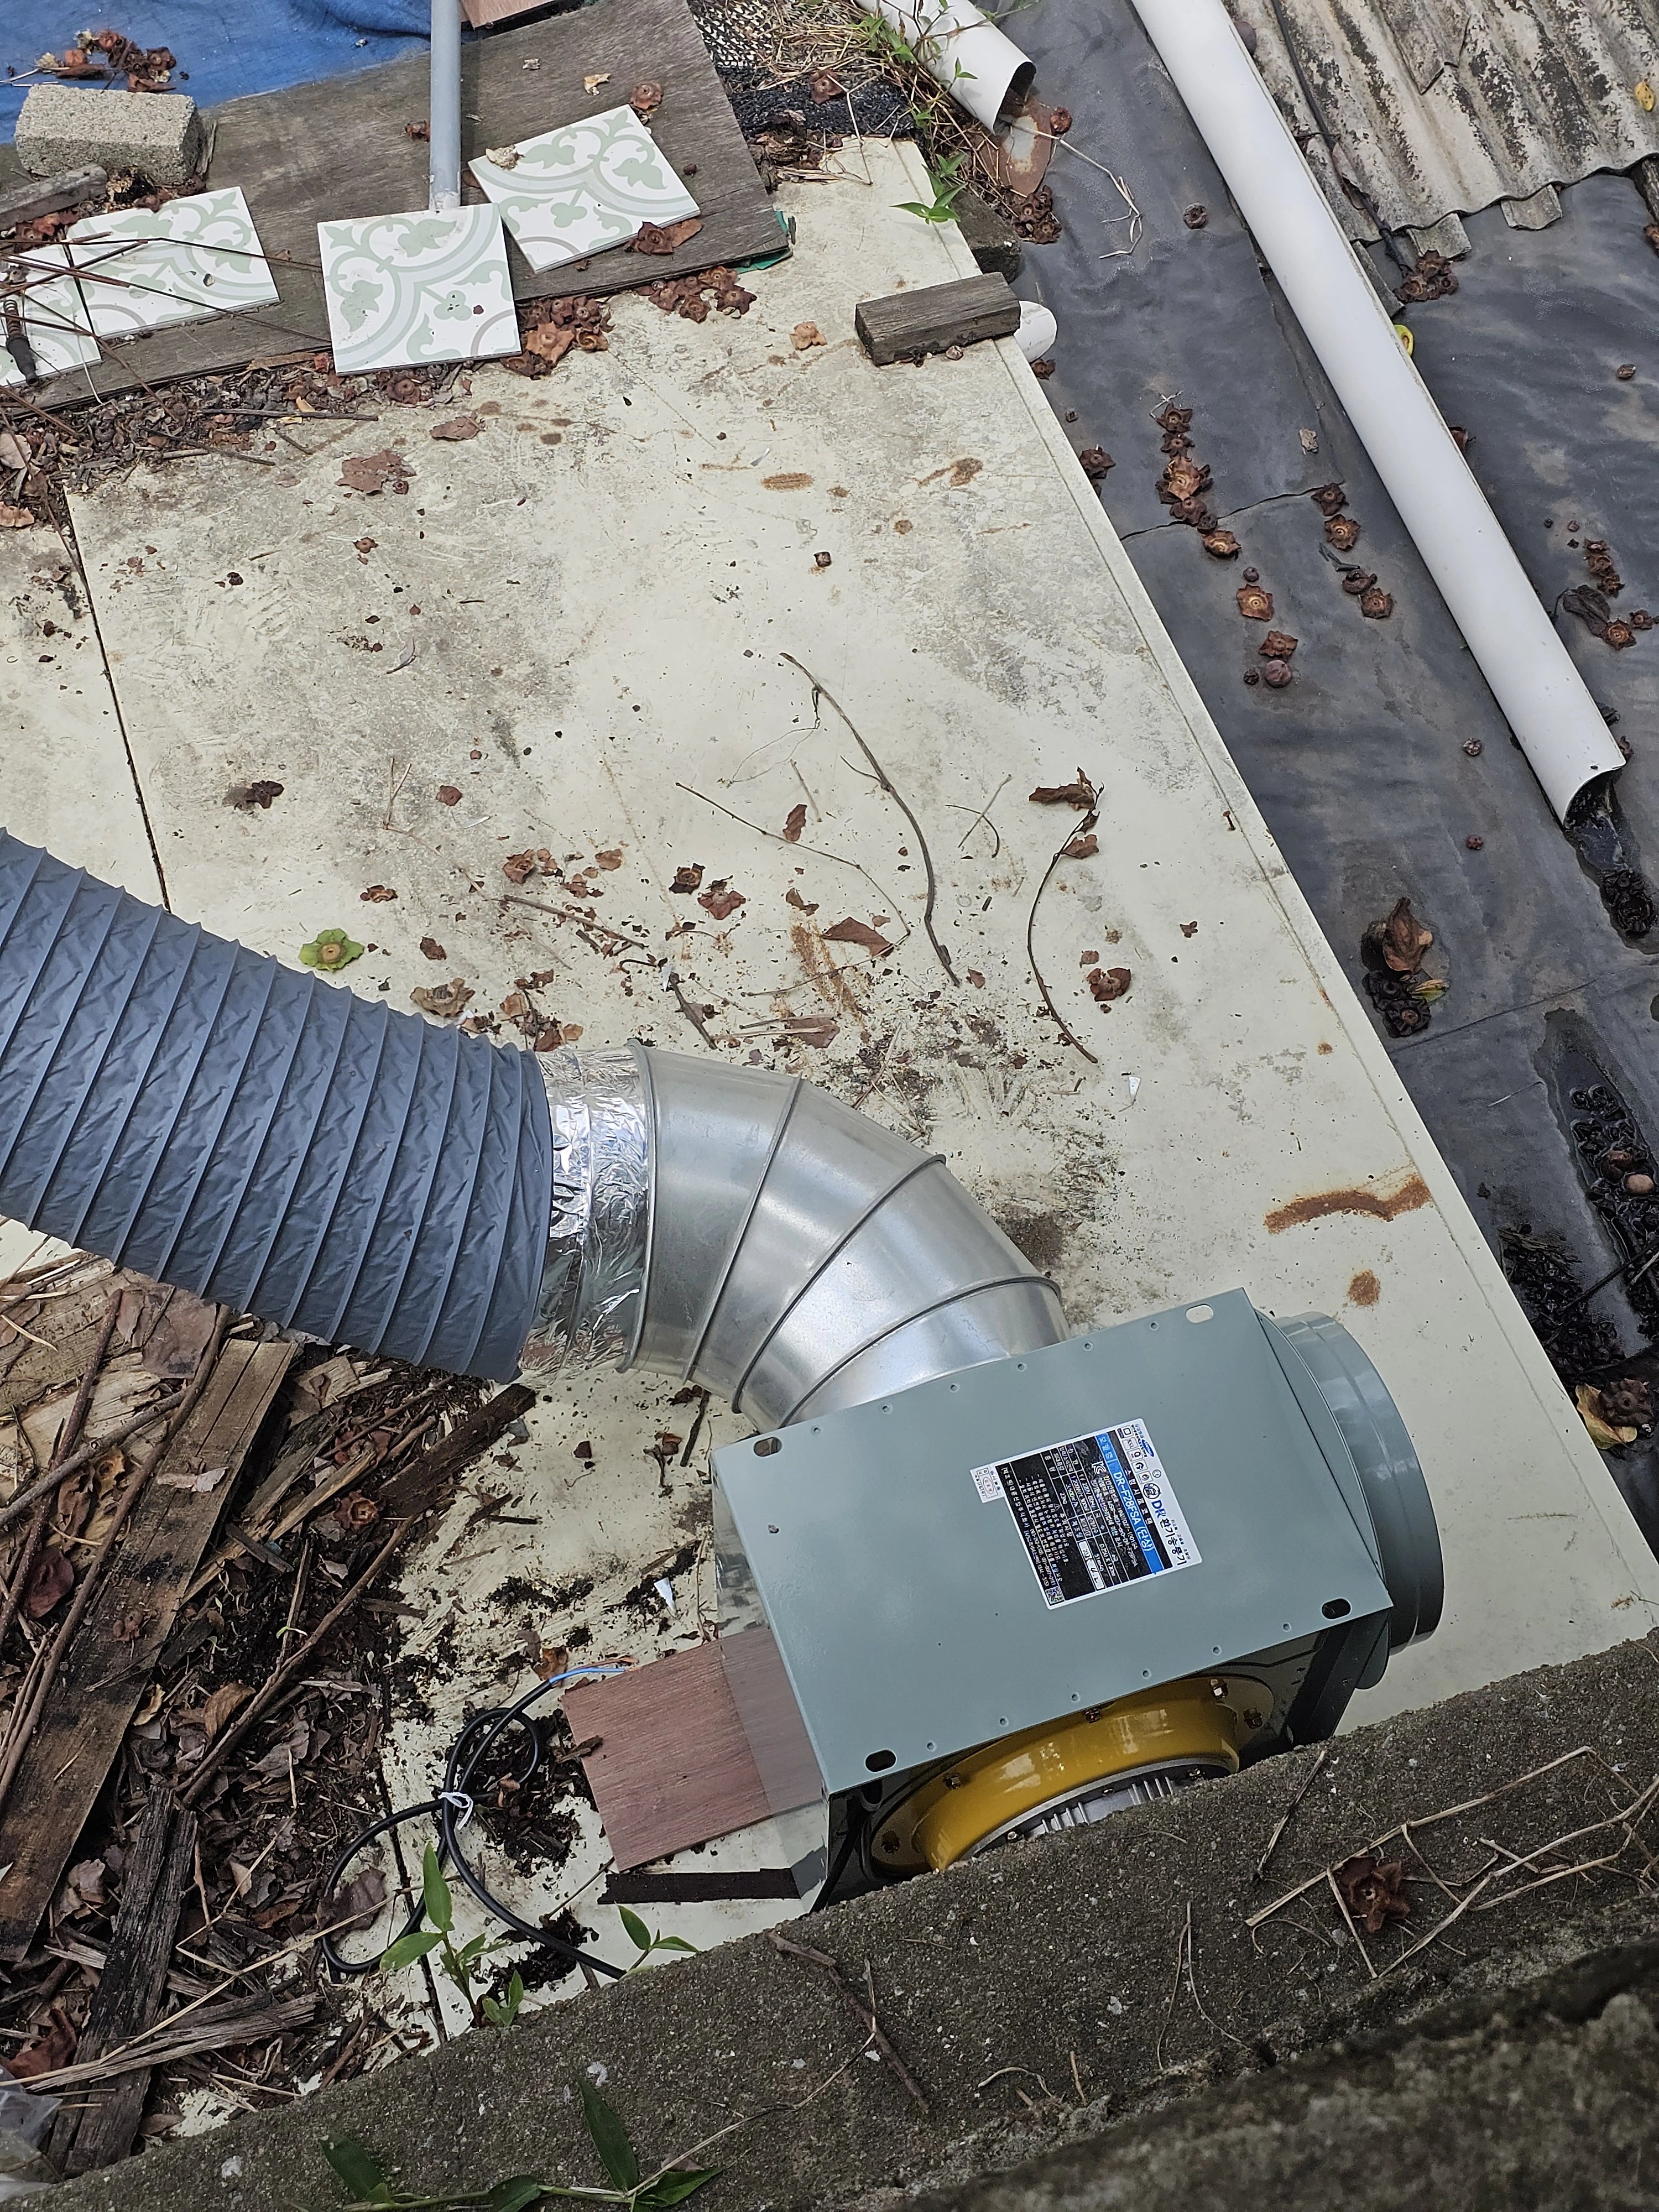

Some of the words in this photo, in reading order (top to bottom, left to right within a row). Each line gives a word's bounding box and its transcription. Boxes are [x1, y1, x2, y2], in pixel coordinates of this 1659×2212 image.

[1113, 1471, 1142, 1525] DR-F28FSA
[1134, 1525, 1154, 1552] (단상)
[1159, 1517, 1187, 1566] 환기송풍기
